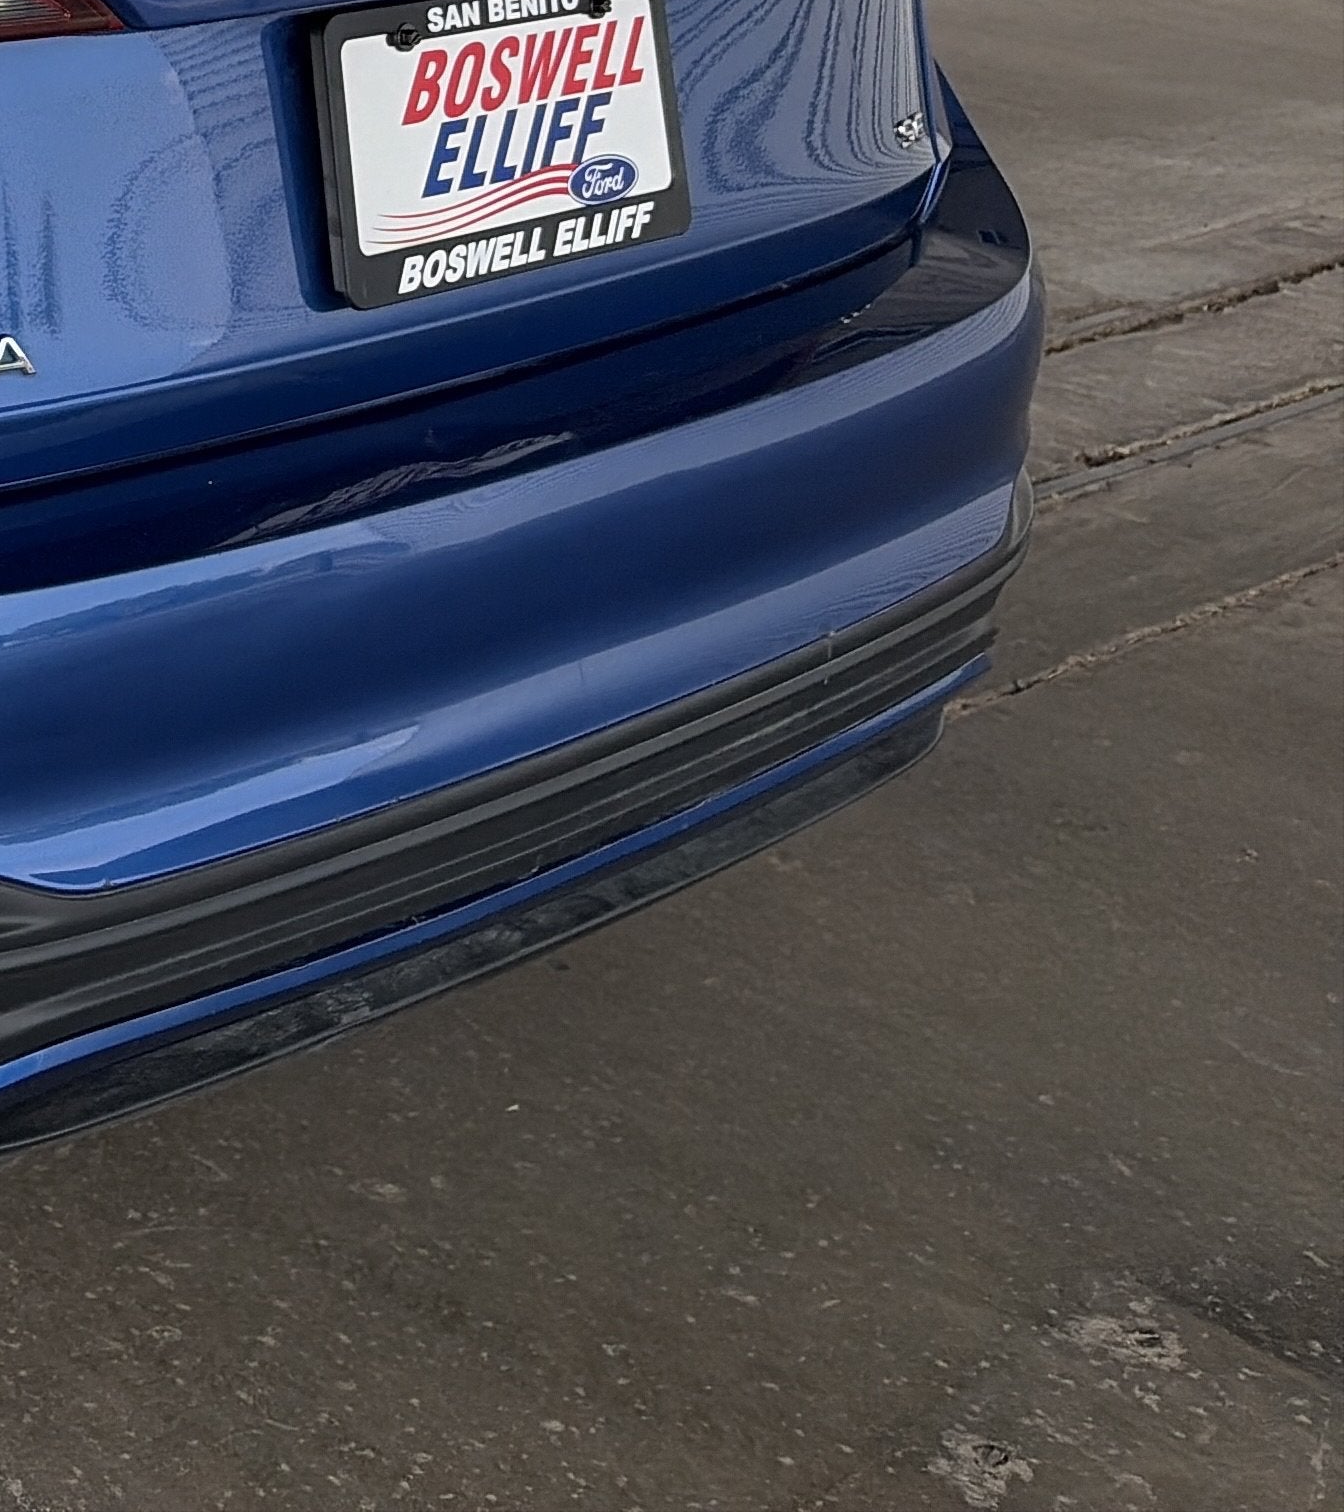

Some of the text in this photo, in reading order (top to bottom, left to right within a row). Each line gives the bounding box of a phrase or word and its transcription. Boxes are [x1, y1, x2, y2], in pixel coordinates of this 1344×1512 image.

[427, 1, 480, 33] SAN
[401, 15, 646, 126] BOSWELL
[421, 91, 613, 199] ELLIFF
[581, 162, 625, 199] Ford
[398, 201, 655, 294] BOSWELL ELLIFF
